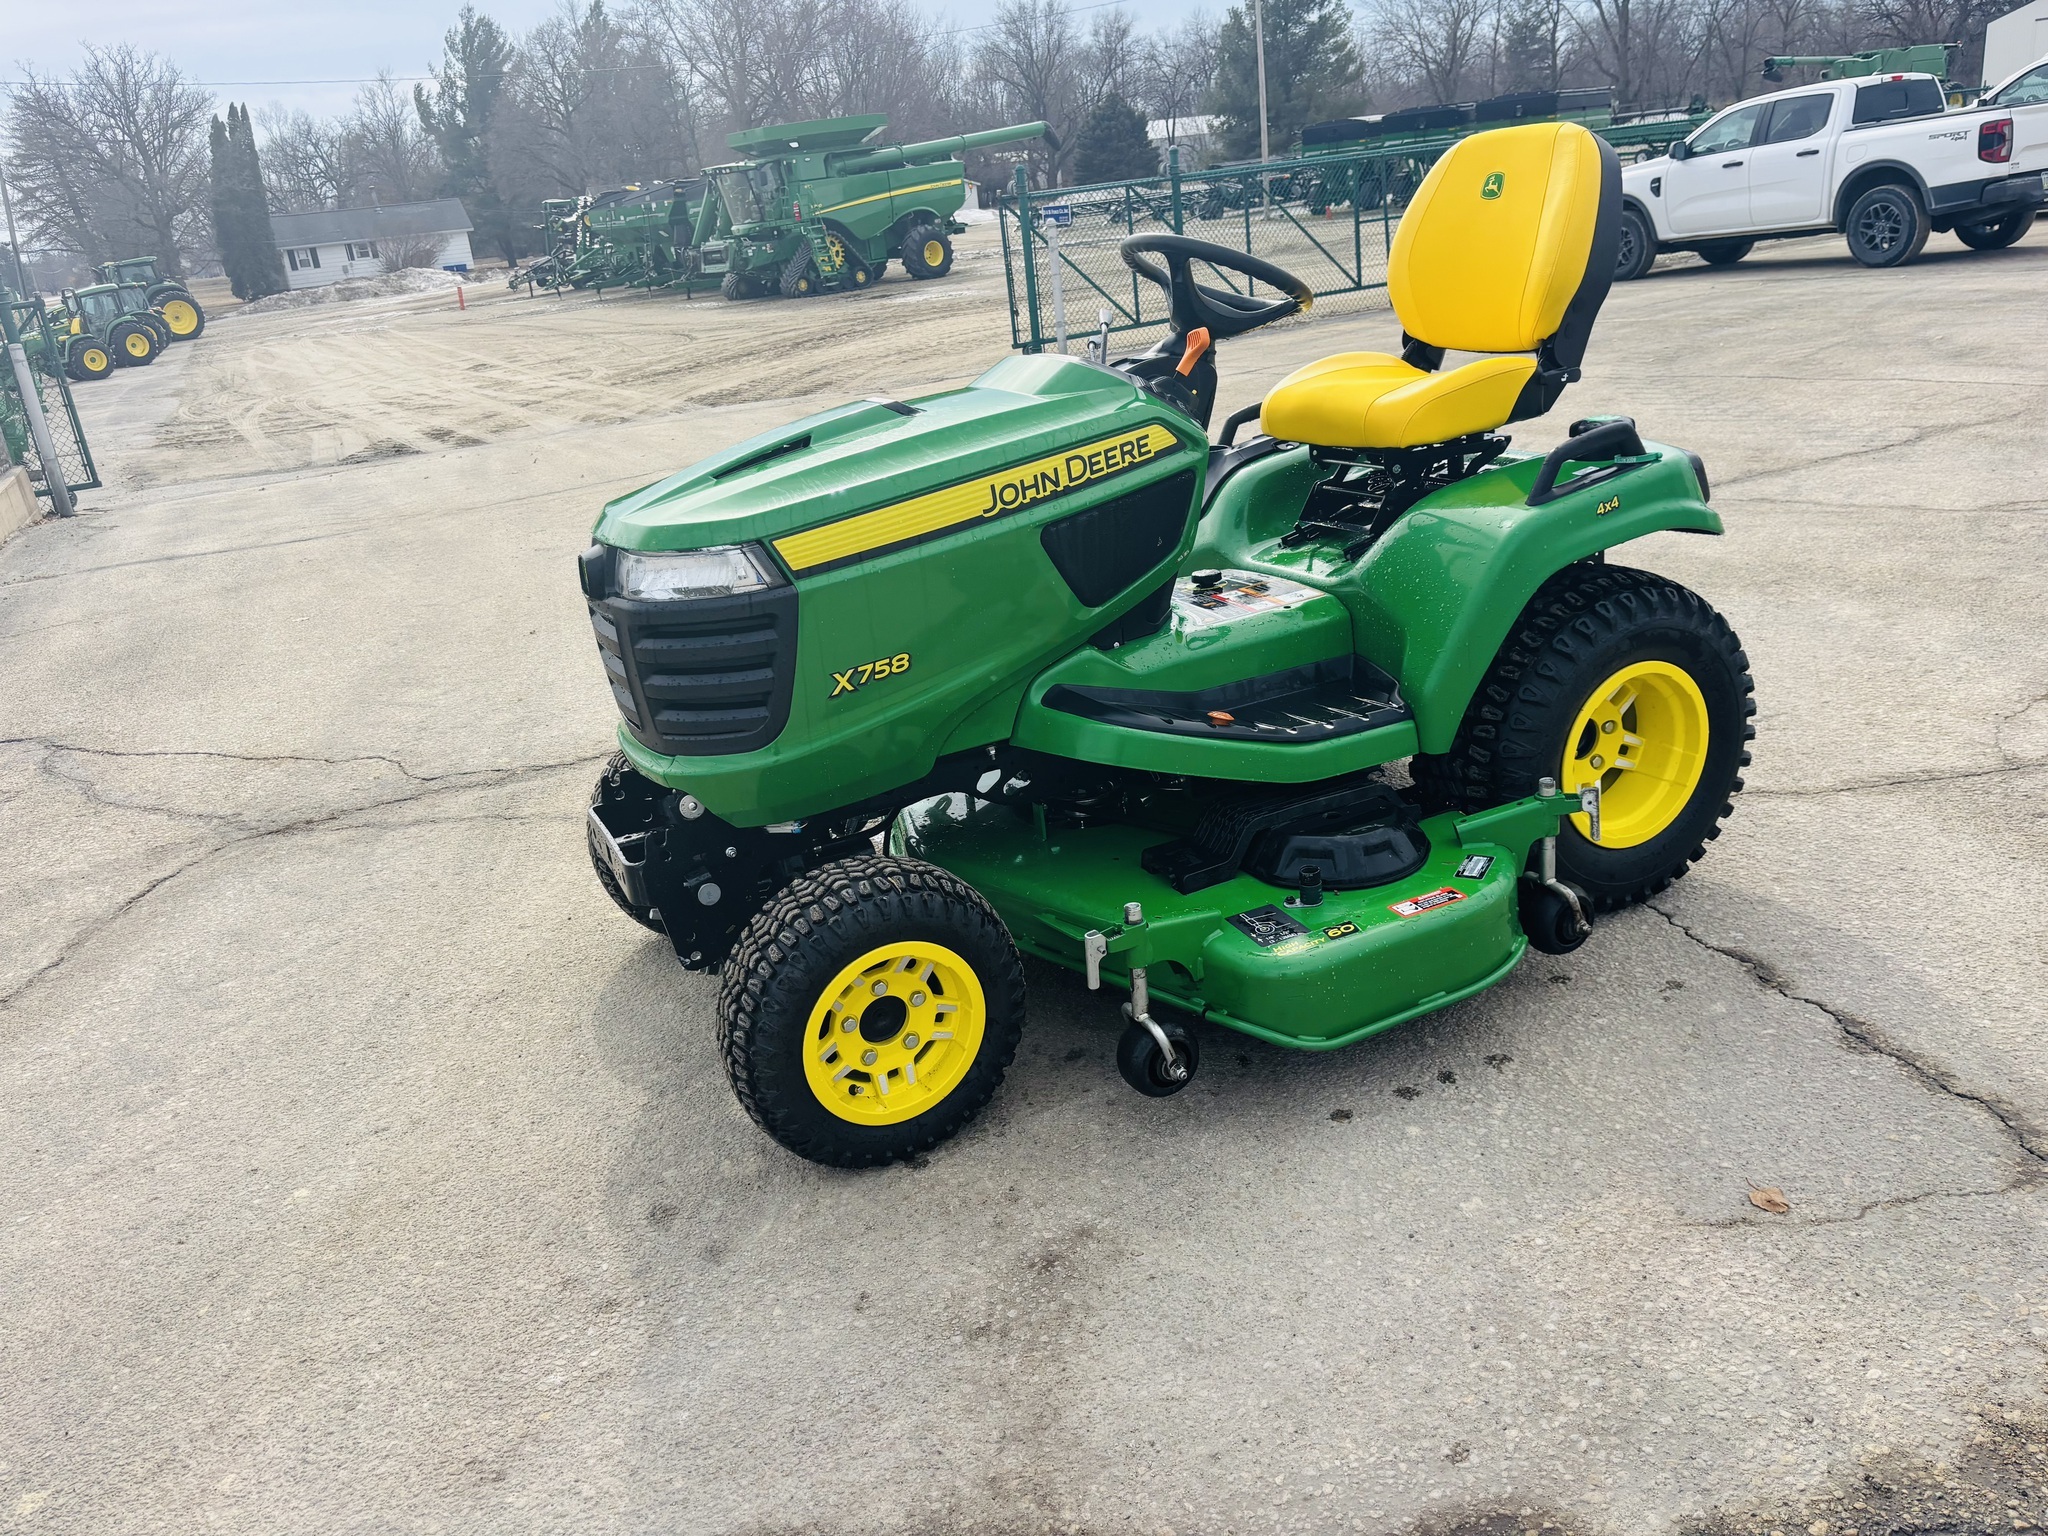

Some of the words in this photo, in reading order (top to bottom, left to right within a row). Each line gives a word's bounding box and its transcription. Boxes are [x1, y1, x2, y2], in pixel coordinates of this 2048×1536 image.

[1928, 130, 1972, 140] SPORT
[983, 467, 1061, 515] JOHN
[1065, 433, 1152, 484] DEERE
[1597, 495, 1619, 514] 4x4
[830, 653, 910, 697] X758
[1327, 924, 1355, 937] 60
[1273, 941, 1299, 952] HIGH
[1277, 937, 1325, 956] CAPACITY
